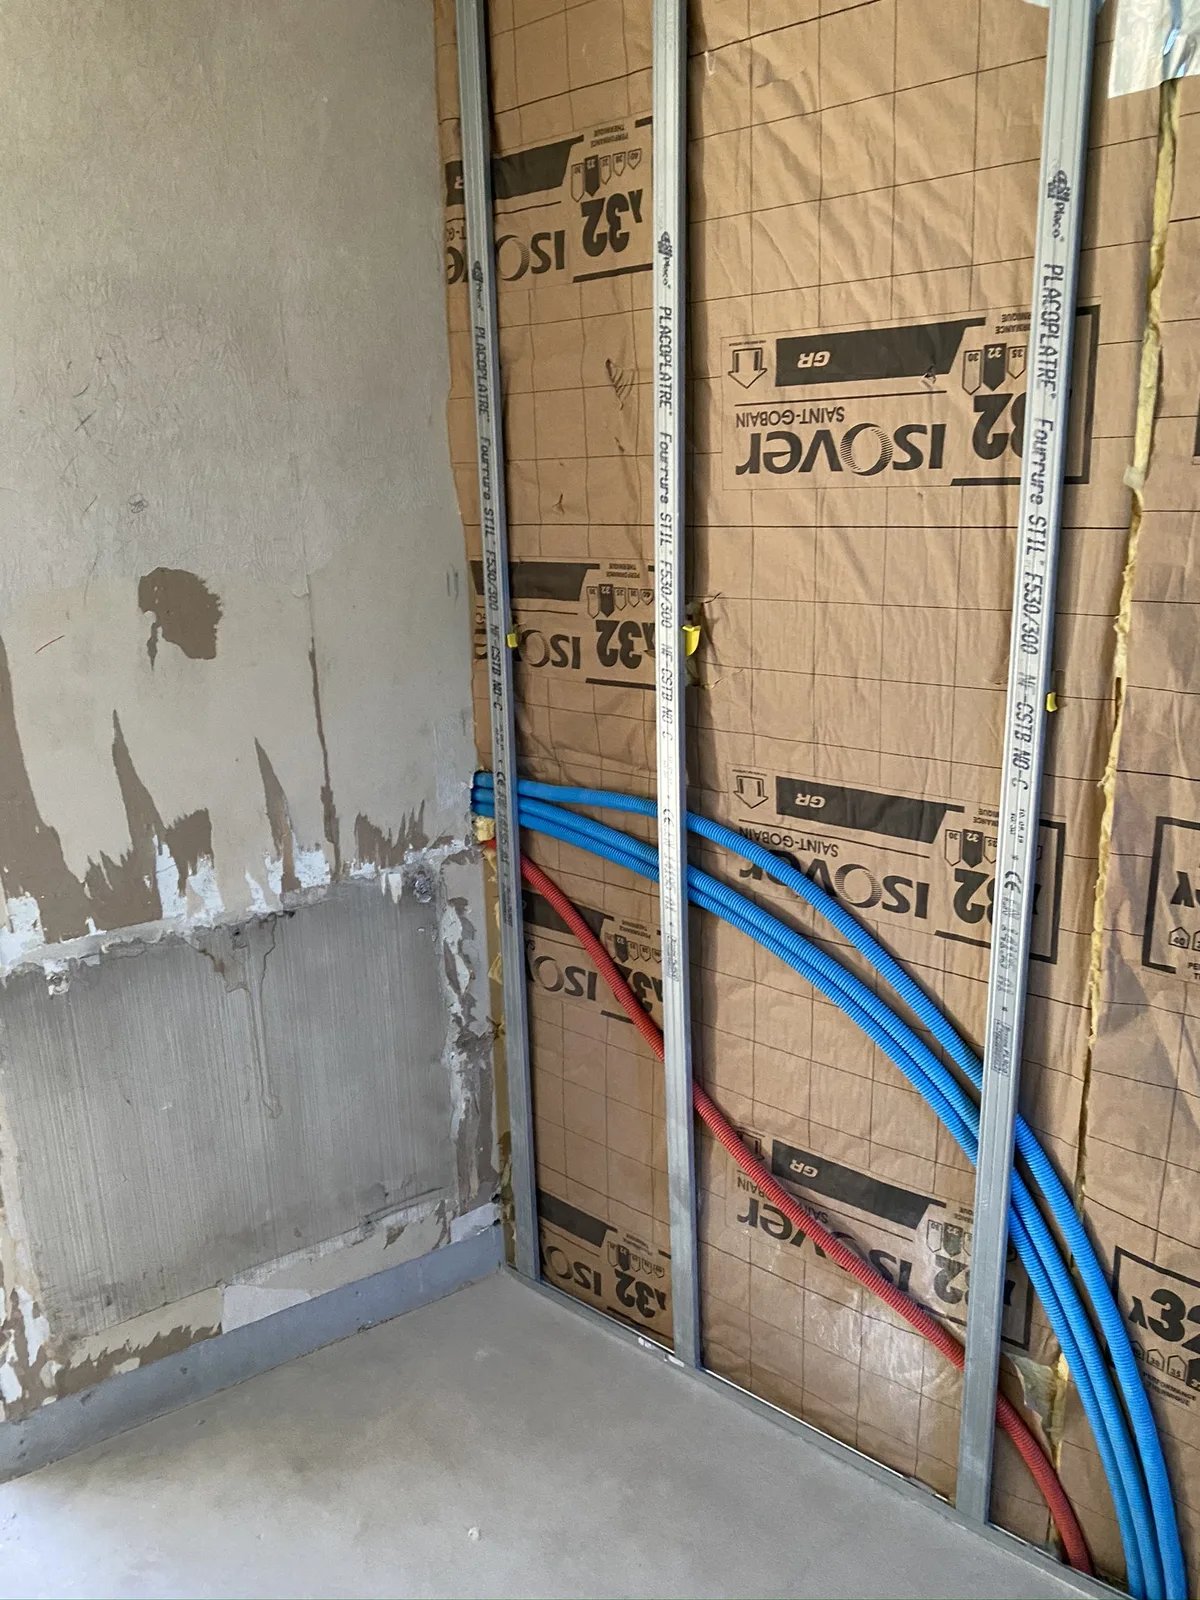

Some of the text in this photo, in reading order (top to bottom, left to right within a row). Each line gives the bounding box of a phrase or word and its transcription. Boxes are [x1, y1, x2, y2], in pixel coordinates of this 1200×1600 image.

[797, 350, 831, 369] GR
[988, 347, 1002, 359] 32
[736, 406, 845, 428] SAINT-GOBAIN
[660, 560, 673, 628] F530/300
[1021, 573, 1043, 655] F530/300
[795, 793, 826, 809] GR
[966, 833, 979, 842] 32
[788, 1160, 818, 1178] GR
